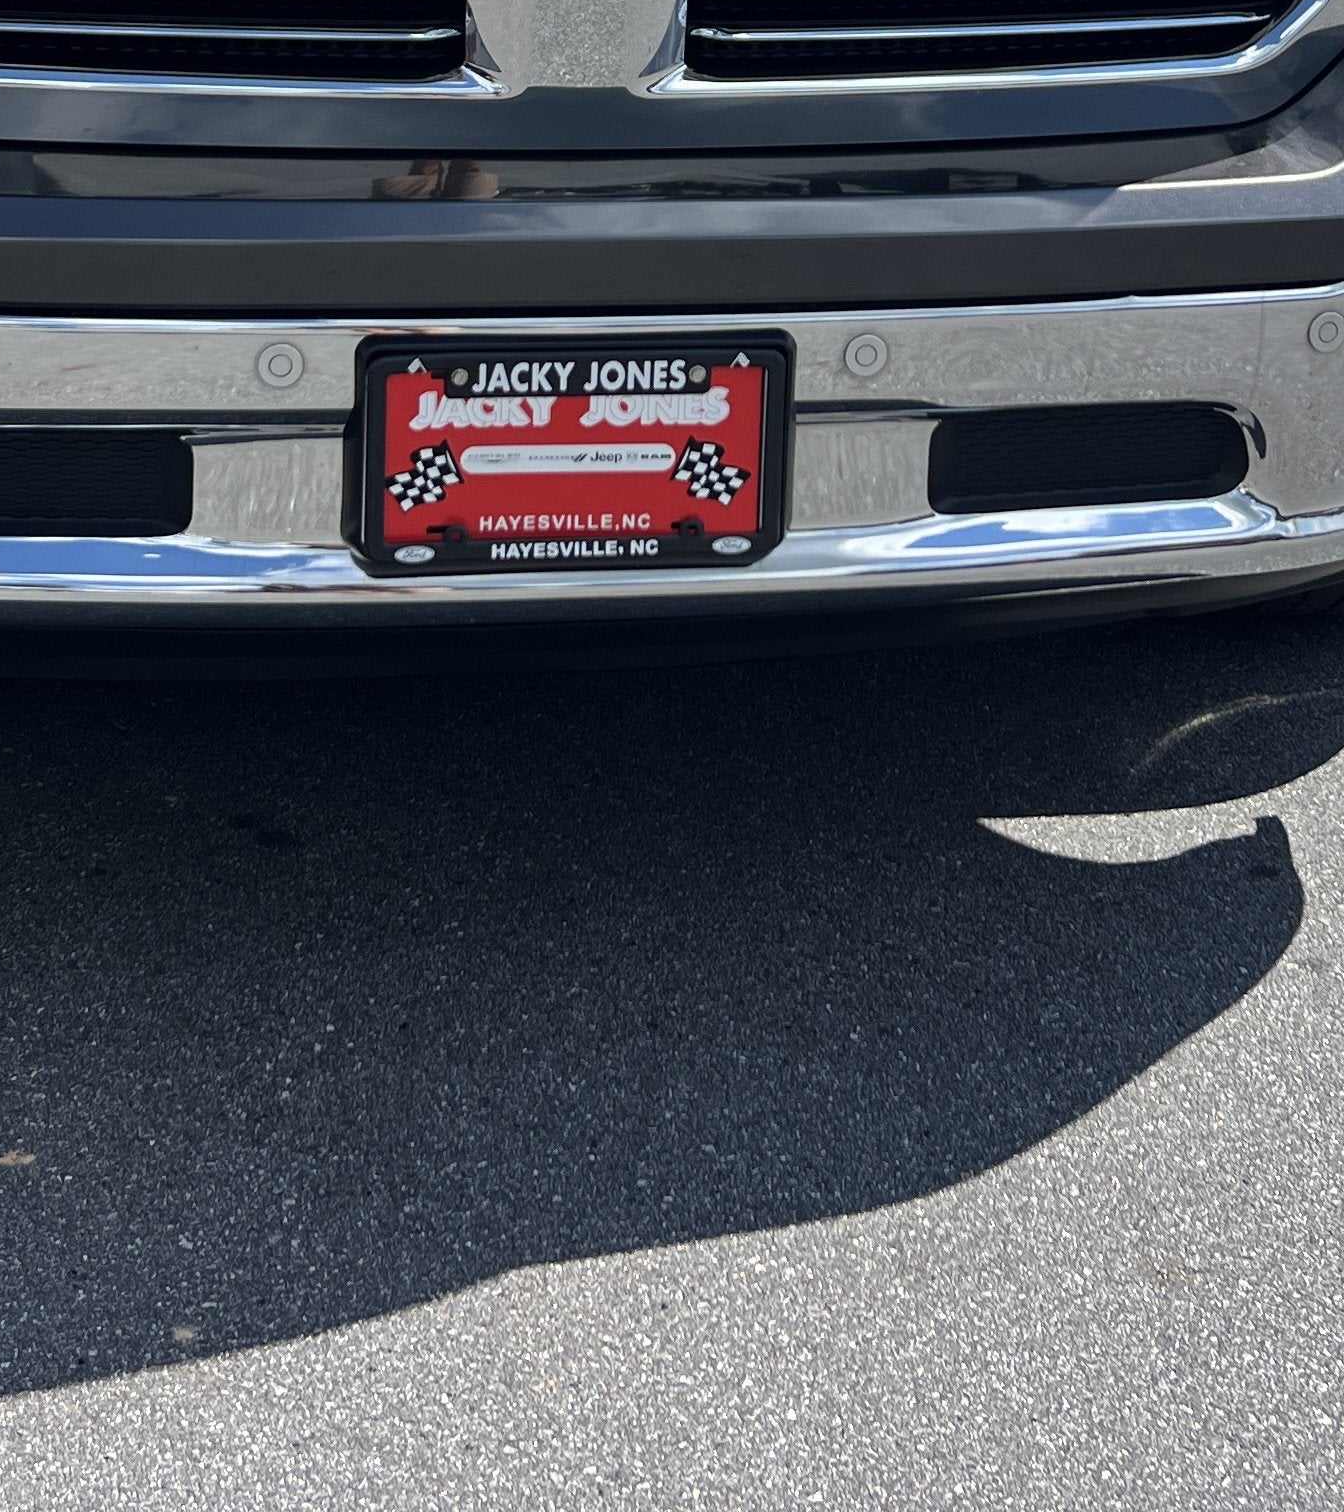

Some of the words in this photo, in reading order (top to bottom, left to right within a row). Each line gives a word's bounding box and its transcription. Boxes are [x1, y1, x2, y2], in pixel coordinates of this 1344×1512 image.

[472, 361, 575, 393] JACKY
[583, 359, 687, 391] JONES
[408, 390, 558, 430] JACKY
[579, 386, 731, 426] JONES
[590, 451, 623, 463] Jeep
[490, 540, 625, 560] HAYESVILLE,
[630, 538, 660, 557] NC
